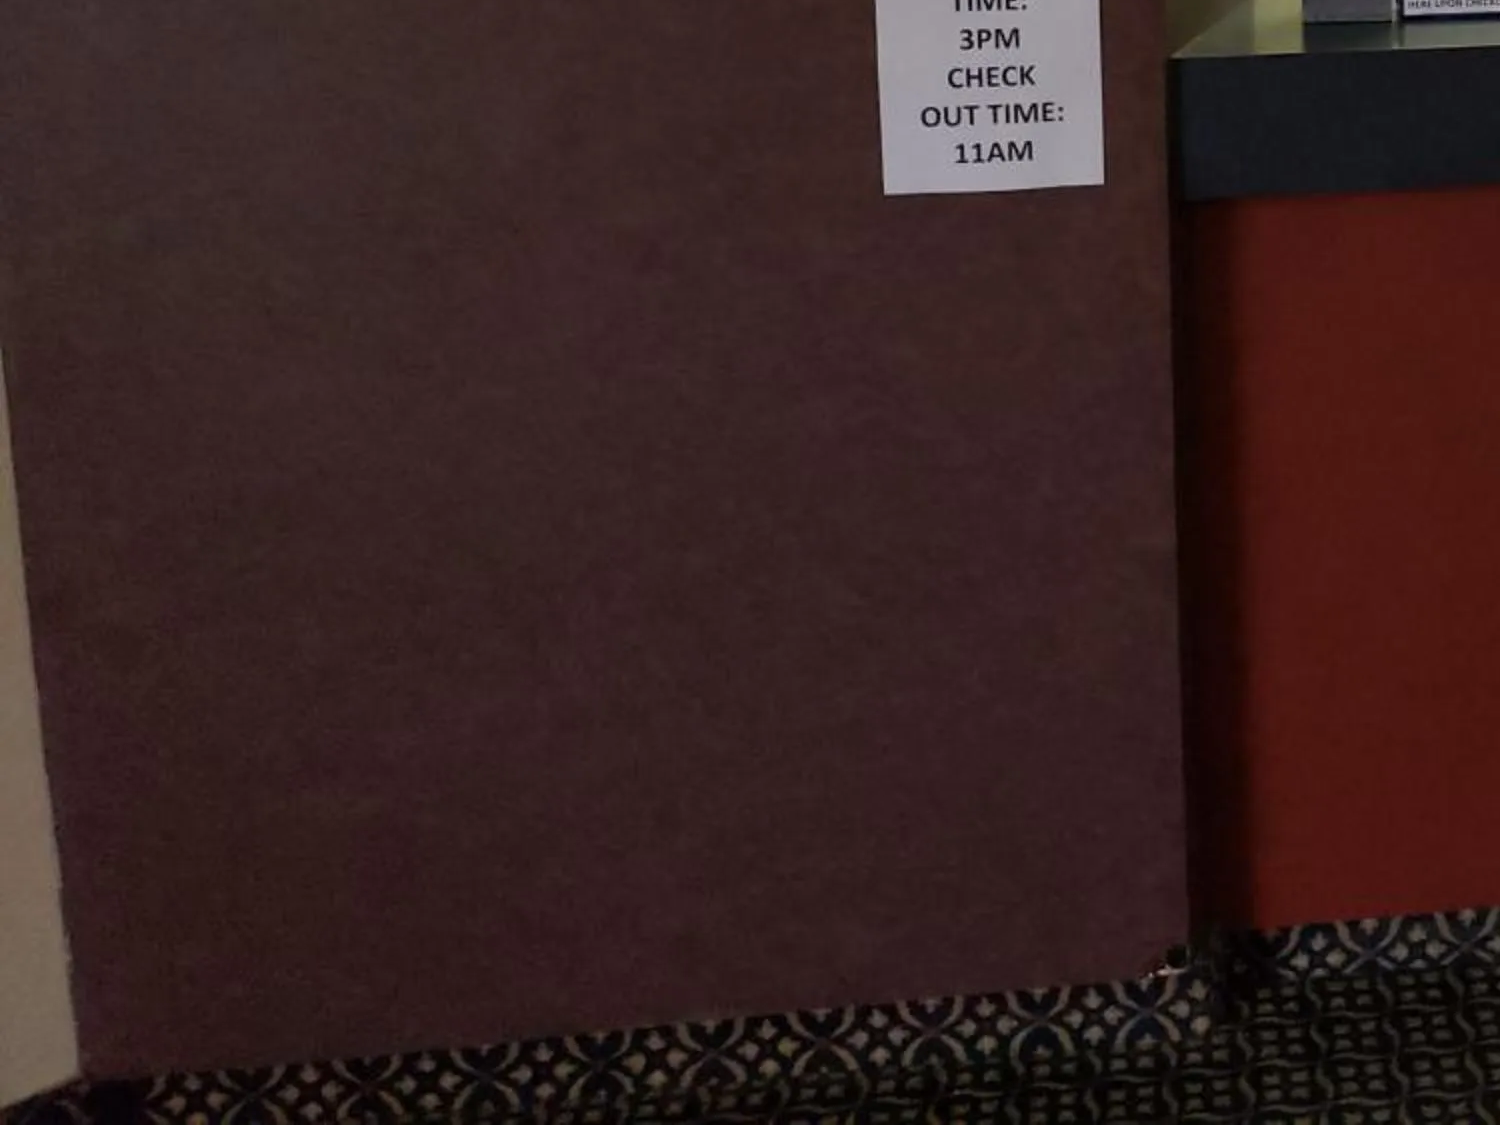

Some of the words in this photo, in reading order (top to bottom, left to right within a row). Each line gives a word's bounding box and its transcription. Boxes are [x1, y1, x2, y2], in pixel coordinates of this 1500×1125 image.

[959, 26, 1021, 51] 3PM
[947, 64, 1036, 89] CHECK
[920, 104, 981, 128] OUT
[986, 101, 1064, 125] TIME:
[955, 140, 1034, 164] 11AM
